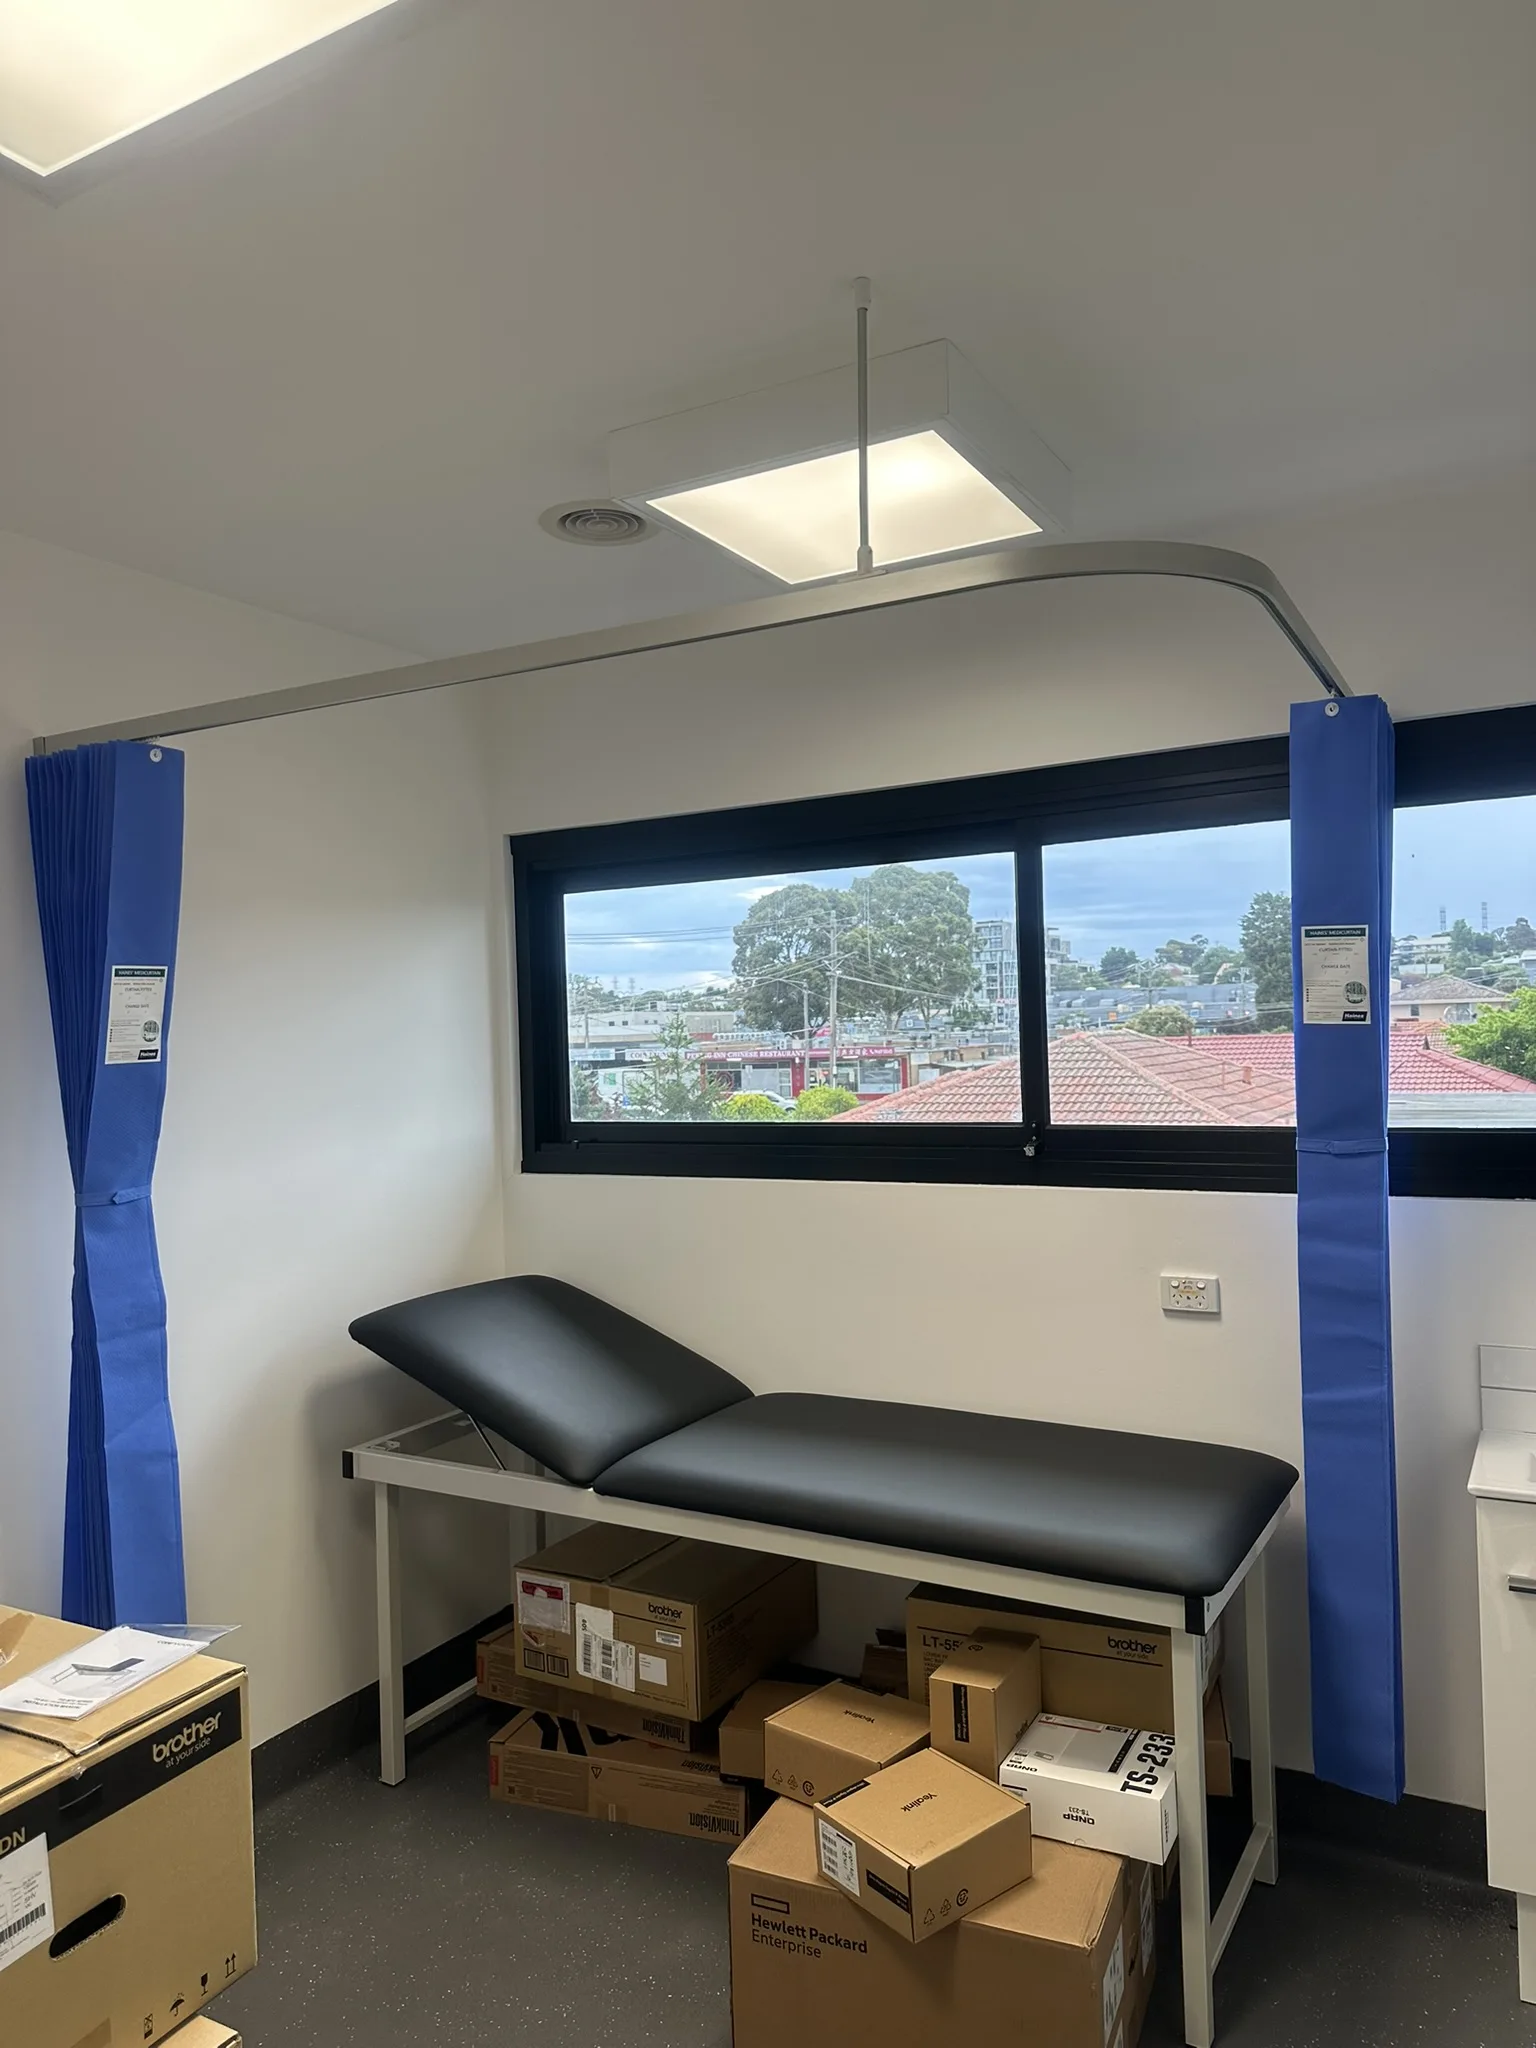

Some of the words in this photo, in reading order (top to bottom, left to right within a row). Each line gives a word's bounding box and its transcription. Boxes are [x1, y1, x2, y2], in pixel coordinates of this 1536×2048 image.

[727, 1050, 759, 1058] CHINESE
[760, 1050, 806, 1058] RESTAURANT
[648, 1601, 683, 1619] brother
[1107, 1635, 1158, 1655] brother
[843, 1709, 876, 1724] Yealink
[152, 1711, 222, 1763] brother
[642, 1717, 686, 1744] ThinkVision
[165, 1757, 175, 1768] at
[176, 1746, 195, 1765] your
[194, 1737, 211, 1752] side
[1006, 1763, 1038, 1773] QNAP
[1120, 1733, 1176, 1794] TS-233
[901, 1792, 938, 1812] Yealink
[1068, 1806, 1090, 1816] TS-233
[688, 1811, 741, 1837] ThinkVision
[1062, 1813, 1095, 1826] QNAP
[751, 1912, 807, 1939] Hewlett
[809, 1927, 868, 1954] Packard
[752, 1928, 822, 1959] Enterprise
